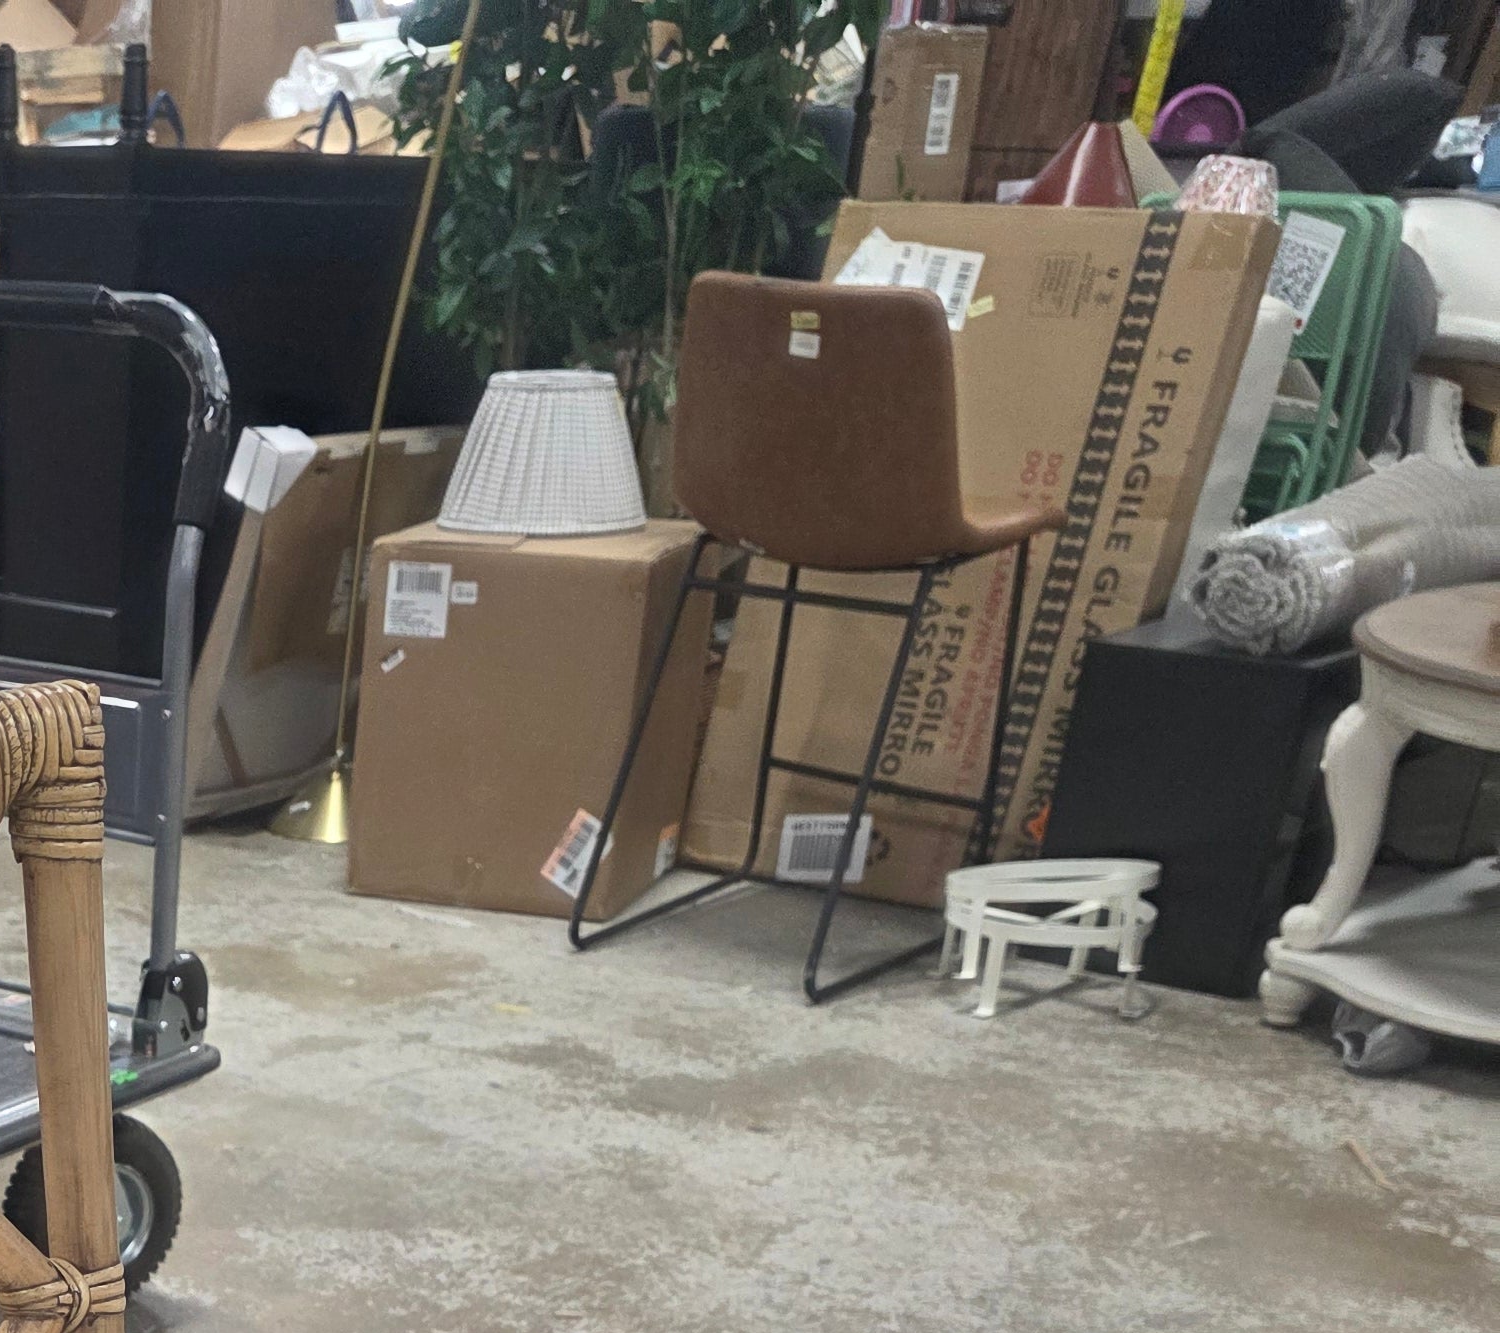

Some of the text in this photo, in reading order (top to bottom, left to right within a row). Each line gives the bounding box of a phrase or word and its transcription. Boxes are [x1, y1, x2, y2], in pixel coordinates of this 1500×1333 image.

[1105, 380, 1178, 552] FRAGILE
[874, 668, 924, 788] MIRRO
[911, 624, 965, 757] FRAGILE
